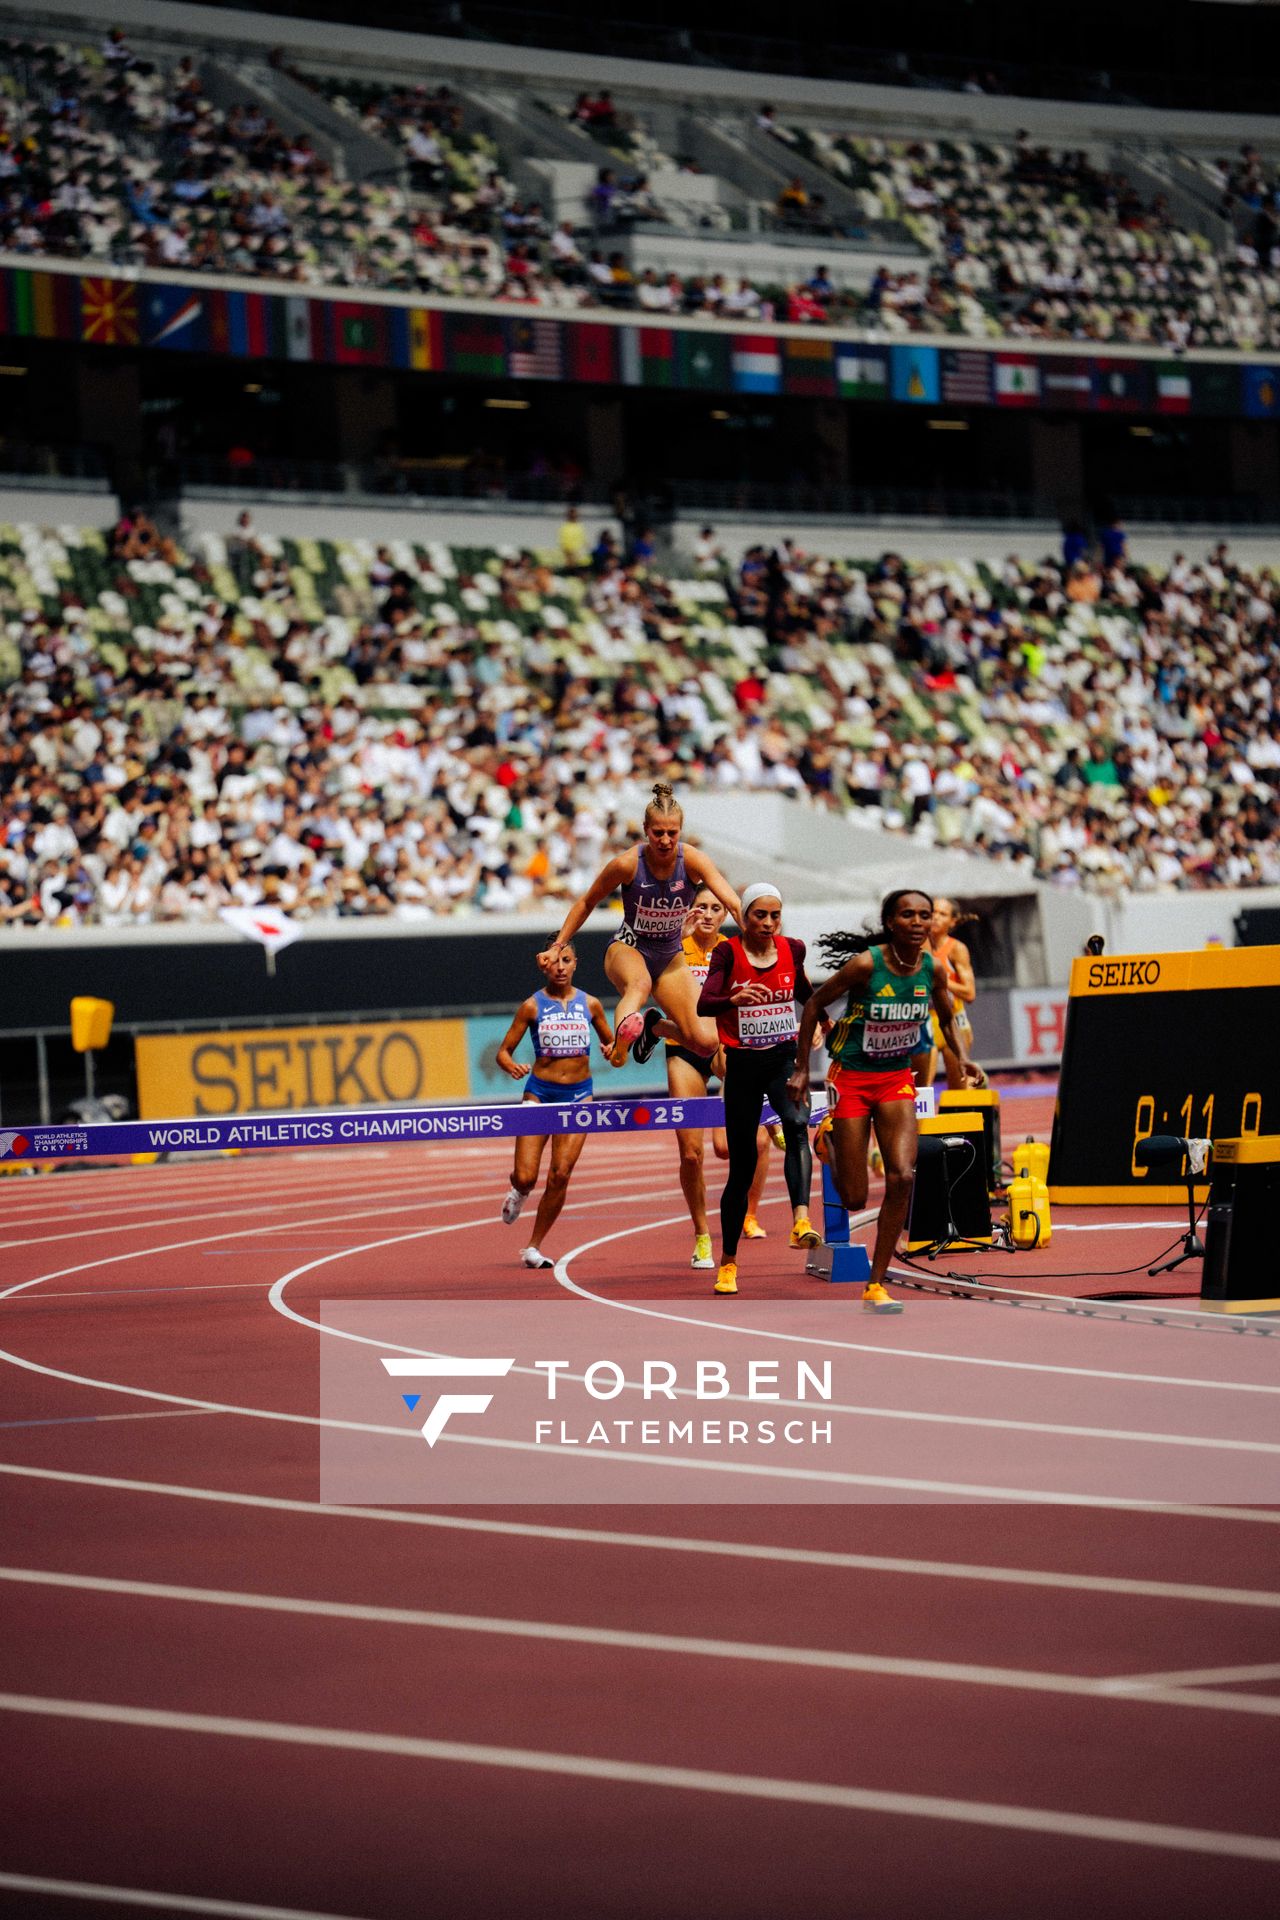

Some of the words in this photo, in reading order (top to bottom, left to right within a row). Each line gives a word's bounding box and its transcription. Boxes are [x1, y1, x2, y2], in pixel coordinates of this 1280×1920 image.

[638, 907, 689, 918] HONDA
[636, 918, 683, 931] NAPOLEO
[1088, 959, 1161, 989] SEIKO
[740, 1005, 793, 1019] HONDA
[871, 1003, 929, 1019] ETHIOPI
[541, 1023, 588, 1031] HONDA
[741, 1018, 795, 1036] BOUZAYANI
[866, 1021, 920, 1033] HONDA
[1024, 1002, 1068, 1057] H
[542, 1034, 587, 1047] COHEN
[867, 1032, 918, 1050] ALMAYEW
[192, 1032, 424, 1115] SEIKO
[914, 1100, 928, 1113] HI
[149, 1127, 221, 1146] WORLD
[228, 1121, 333, 1143] ATHLETICS
[340, 1115, 503, 1138] CHAMPIONSHIPS
